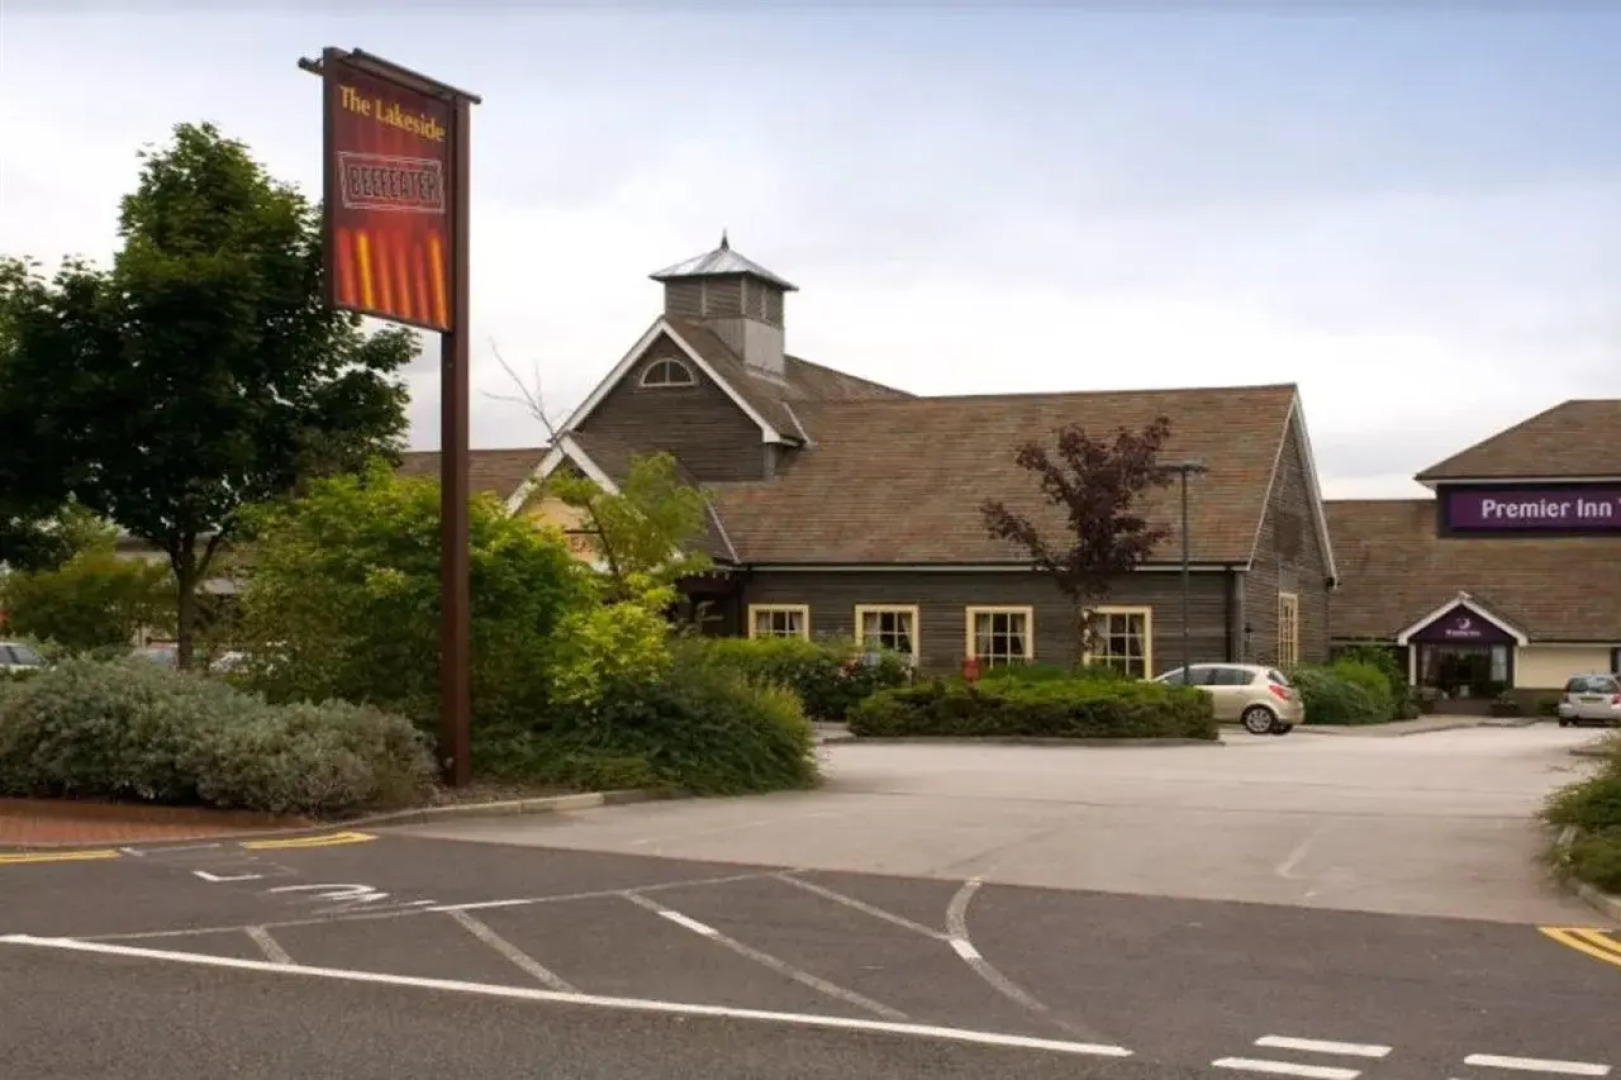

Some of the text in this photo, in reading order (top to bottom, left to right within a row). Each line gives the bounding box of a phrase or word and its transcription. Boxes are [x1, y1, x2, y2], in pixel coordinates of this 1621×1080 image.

[340, 86, 445, 142] The Lakeside
[349, 165, 439, 200] BEEFEATER
[1481, 498, 1612, 518] Premier Inn
